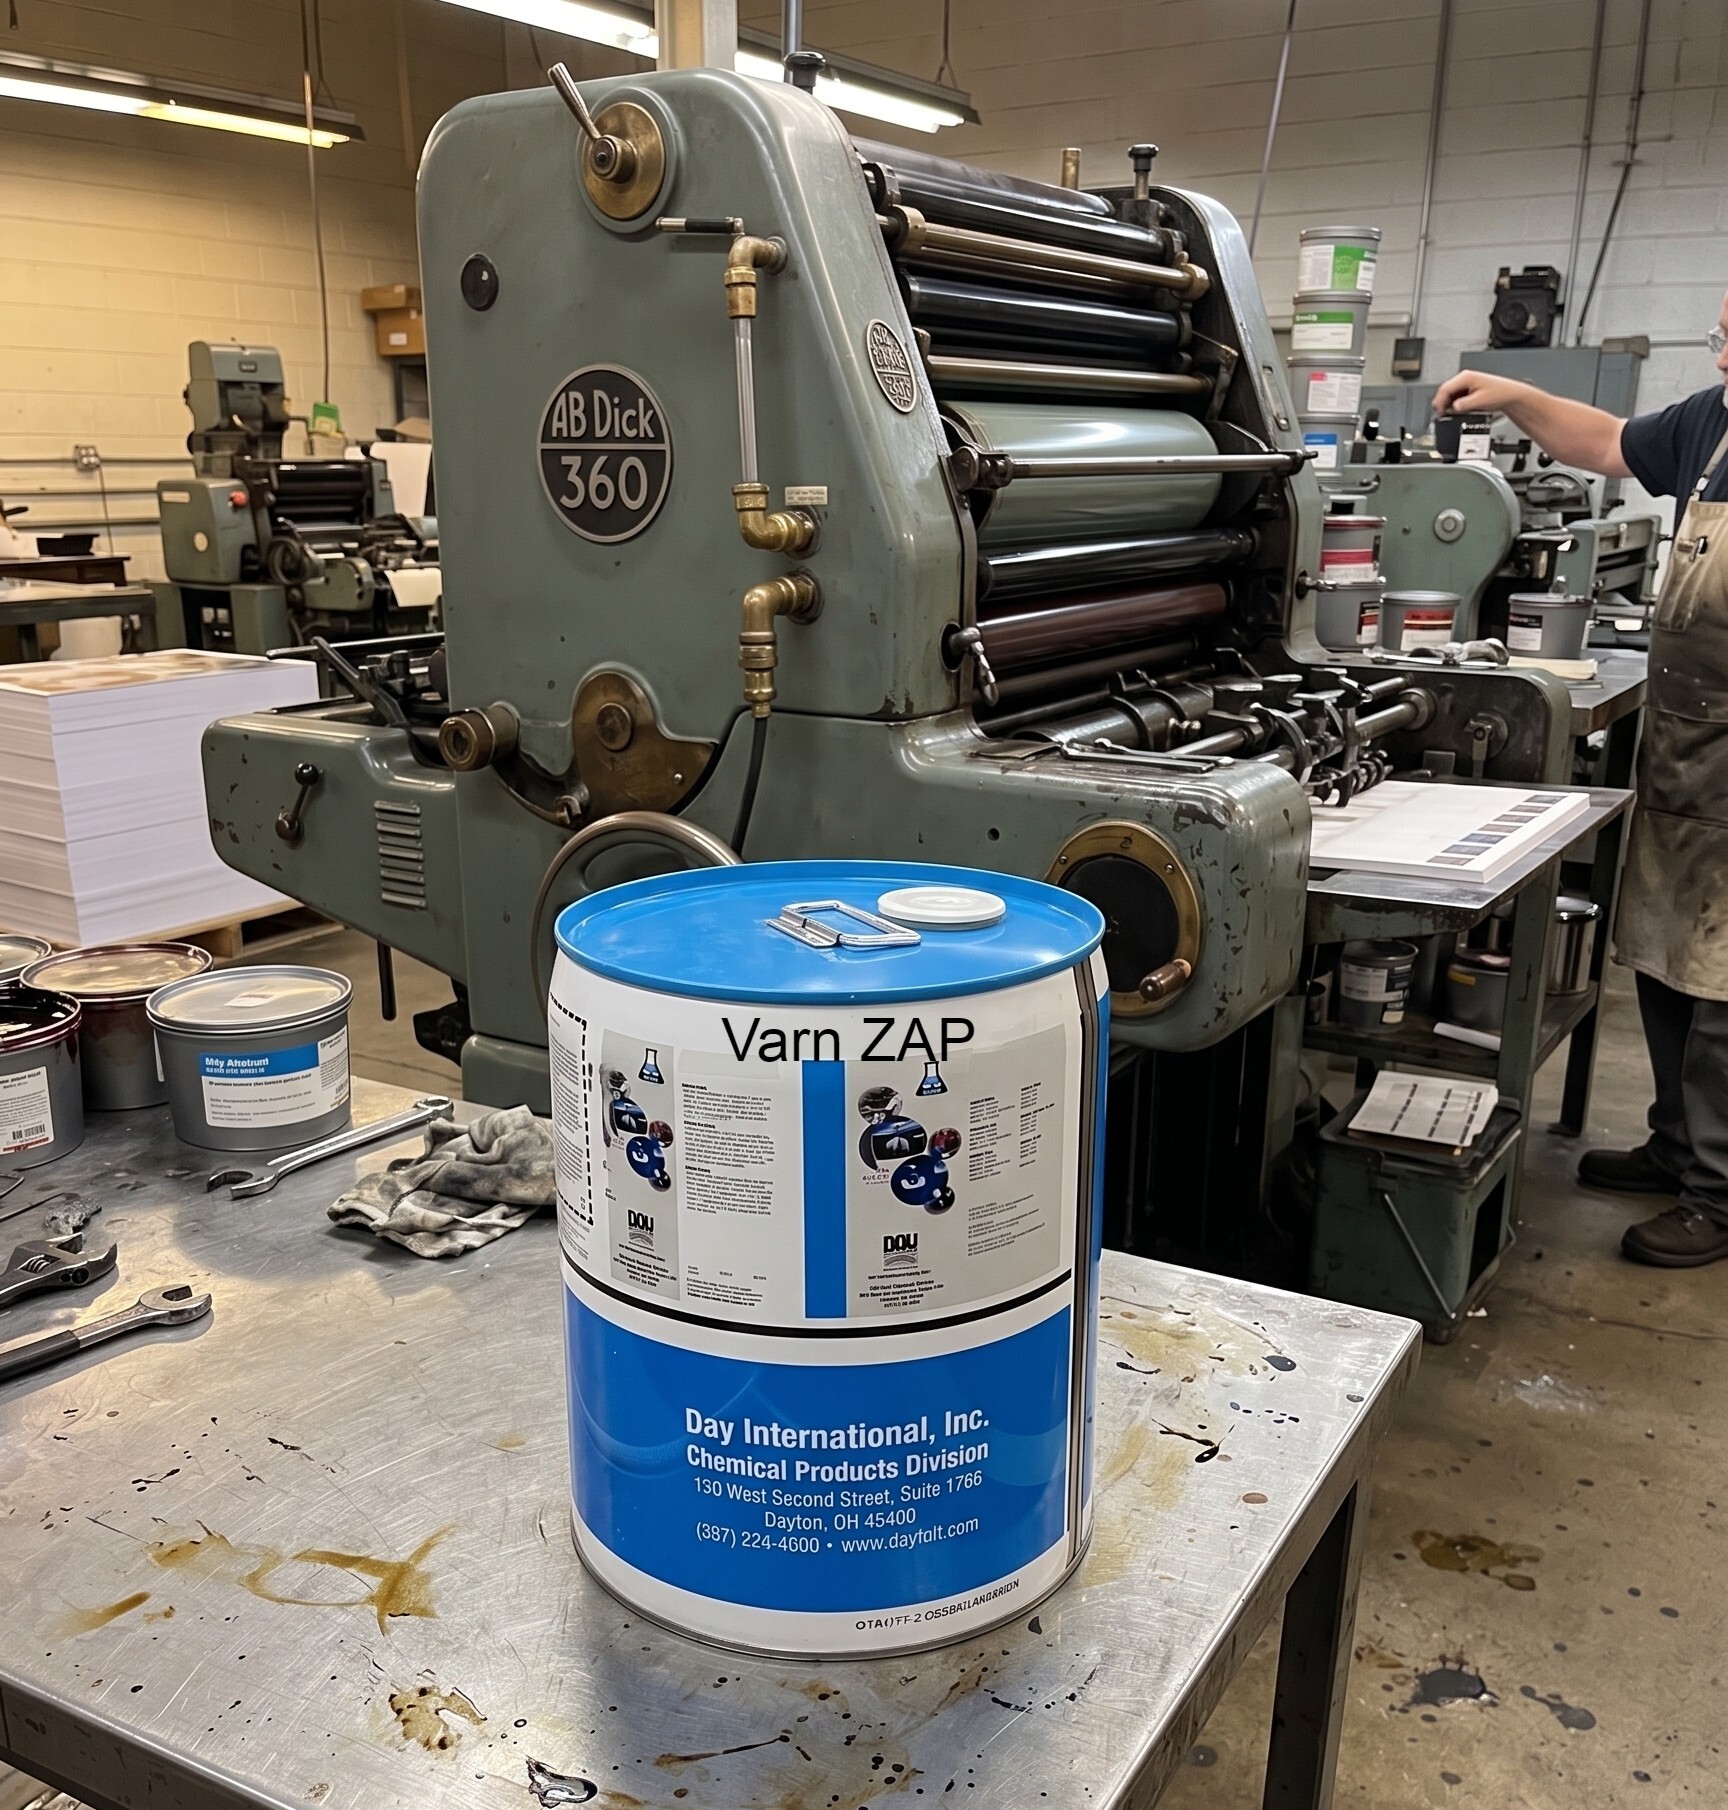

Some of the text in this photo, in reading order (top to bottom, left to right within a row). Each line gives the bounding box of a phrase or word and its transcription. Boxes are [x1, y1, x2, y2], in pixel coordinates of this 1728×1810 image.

[551, 389, 655, 438] AB Dick
[560, 455, 648, 511] 360
[685, 1407, 990, 1449] Day International, Inc.
[687, 1441, 989, 1482] Chemical Products Division
[694, 1470, 983, 1508] 130 West Second Street, Suite 1766
[696, 1521, 737, 1549] (387)
[741, 1531, 820, 1553] 224-4600
[765, 1507, 916, 1533] Dayton, OH 45400
